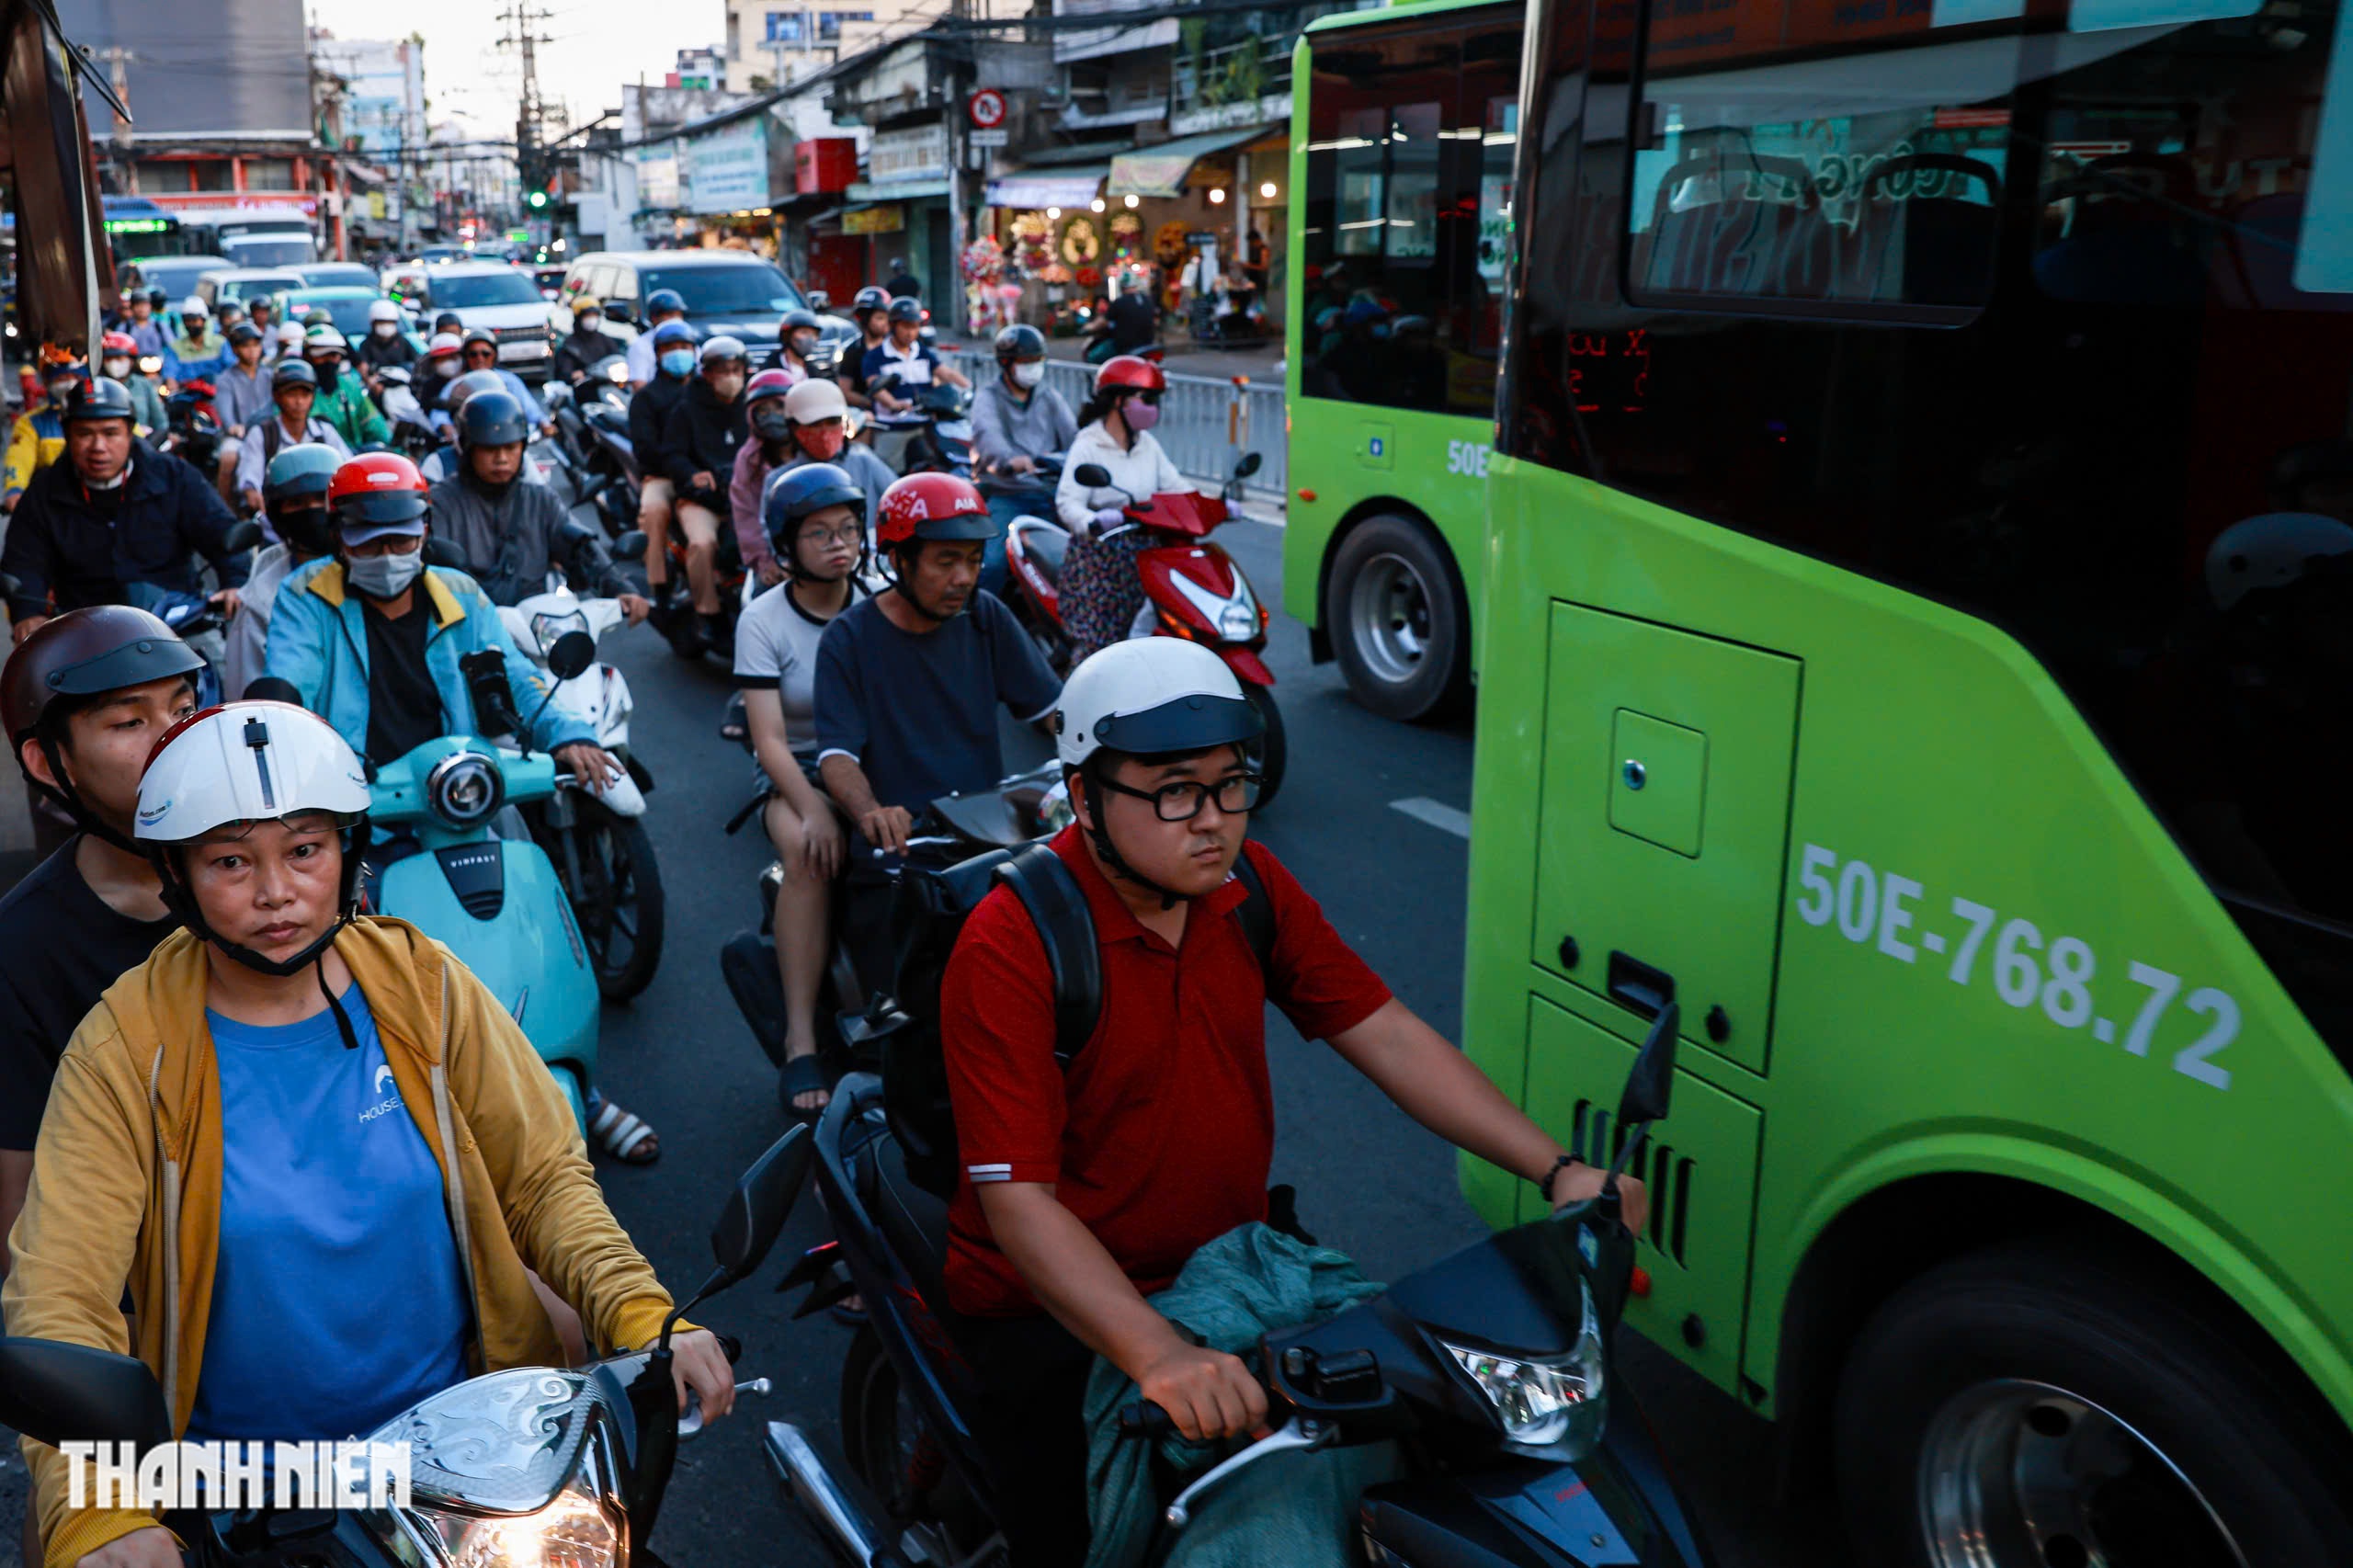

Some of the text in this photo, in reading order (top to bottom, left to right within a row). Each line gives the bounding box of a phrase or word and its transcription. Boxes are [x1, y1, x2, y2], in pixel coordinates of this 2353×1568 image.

[449, 854, 495, 869] VINFAST
[1796, 842, 2242, 1092] 50E-768.72
[358, 1096, 399, 1123] HOUSE
